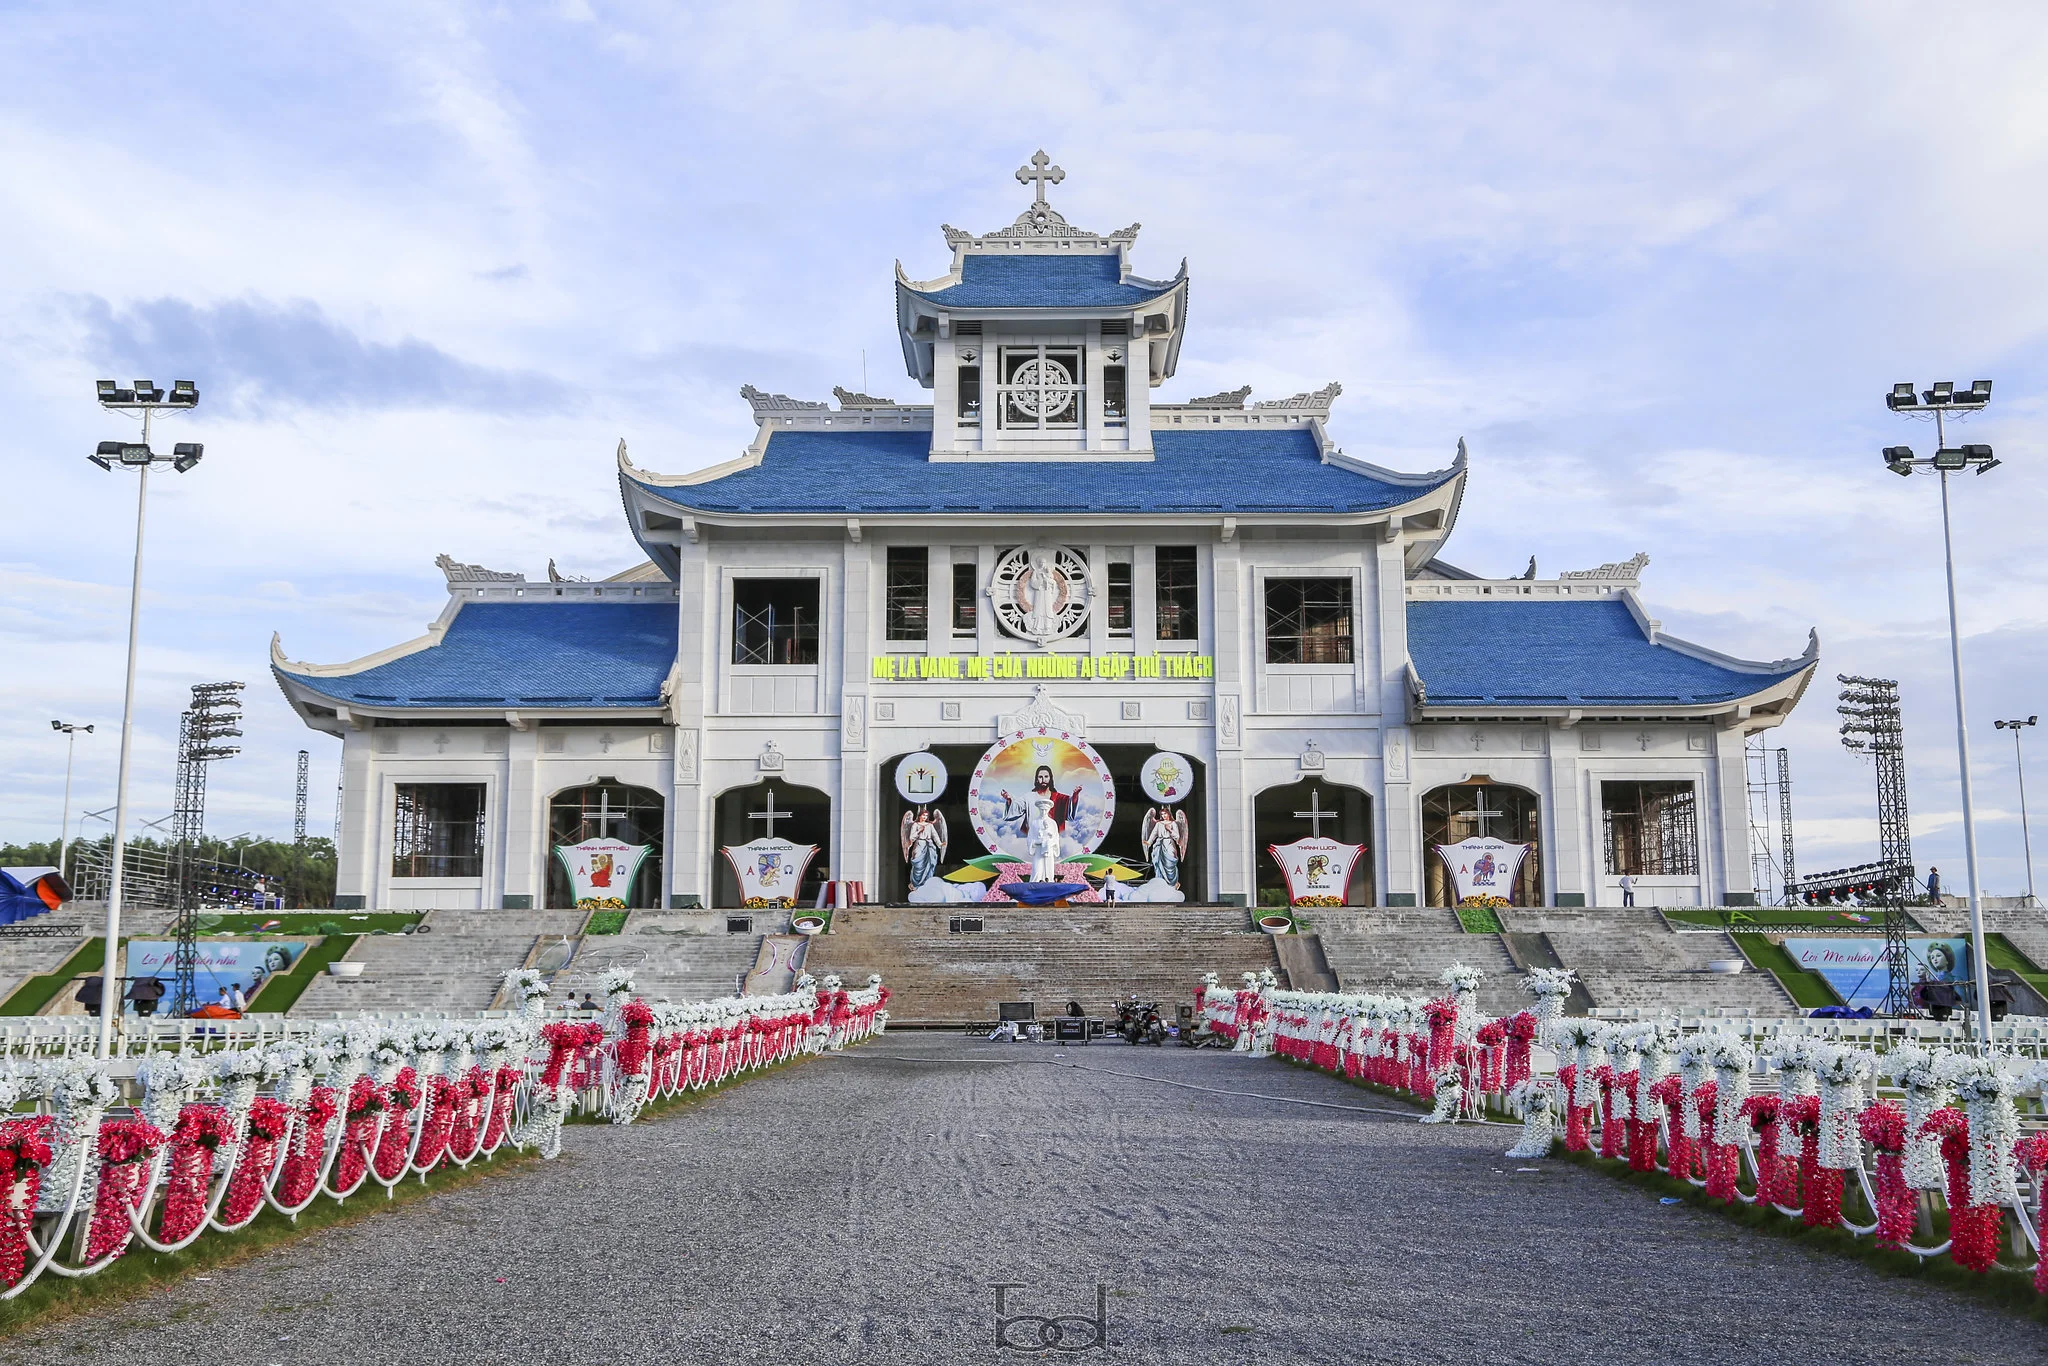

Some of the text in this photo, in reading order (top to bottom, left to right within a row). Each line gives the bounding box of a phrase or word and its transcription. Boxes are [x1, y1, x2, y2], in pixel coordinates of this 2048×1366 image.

[873, 656, 896, 681] MẸ
[899, 656, 917, 678] LA
[919, 656, 964, 680] VANG,
[967, 656, 990, 681] MẸ
[993, 650, 1023, 678] CỦA
[1080, 656, 1096, 678] AI
[1098, 651, 1129, 681] GẶP
[1164, 651, 1213, 678] THÁCH
